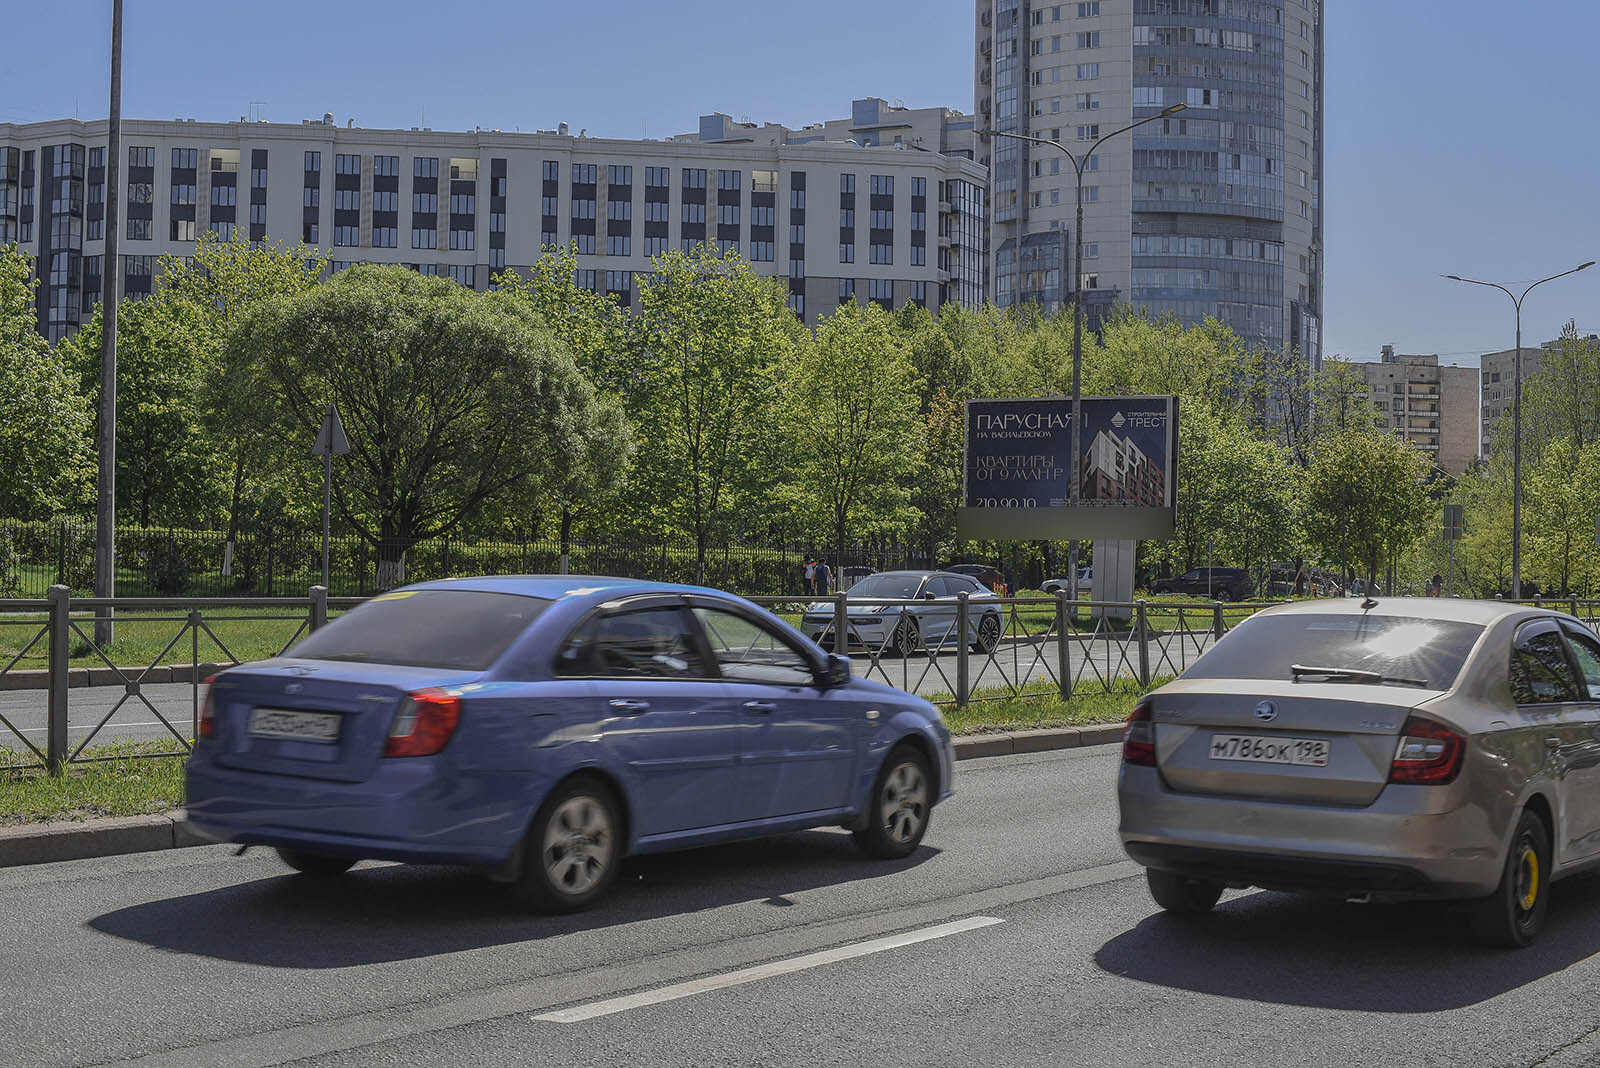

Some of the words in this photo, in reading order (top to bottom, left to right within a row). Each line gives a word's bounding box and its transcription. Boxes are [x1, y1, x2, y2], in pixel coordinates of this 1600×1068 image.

[977, 413, 1072, 429] ПАРУСНАЯ
[1128, 417, 1168, 428] ТРЕСТ
[976, 455, 1054, 468] КВАРТИРЫ
[976, 468, 996, 480] ОТ
[999, 468, 1009, 480] 9
[1013, 468, 1049, 480] МЛН
